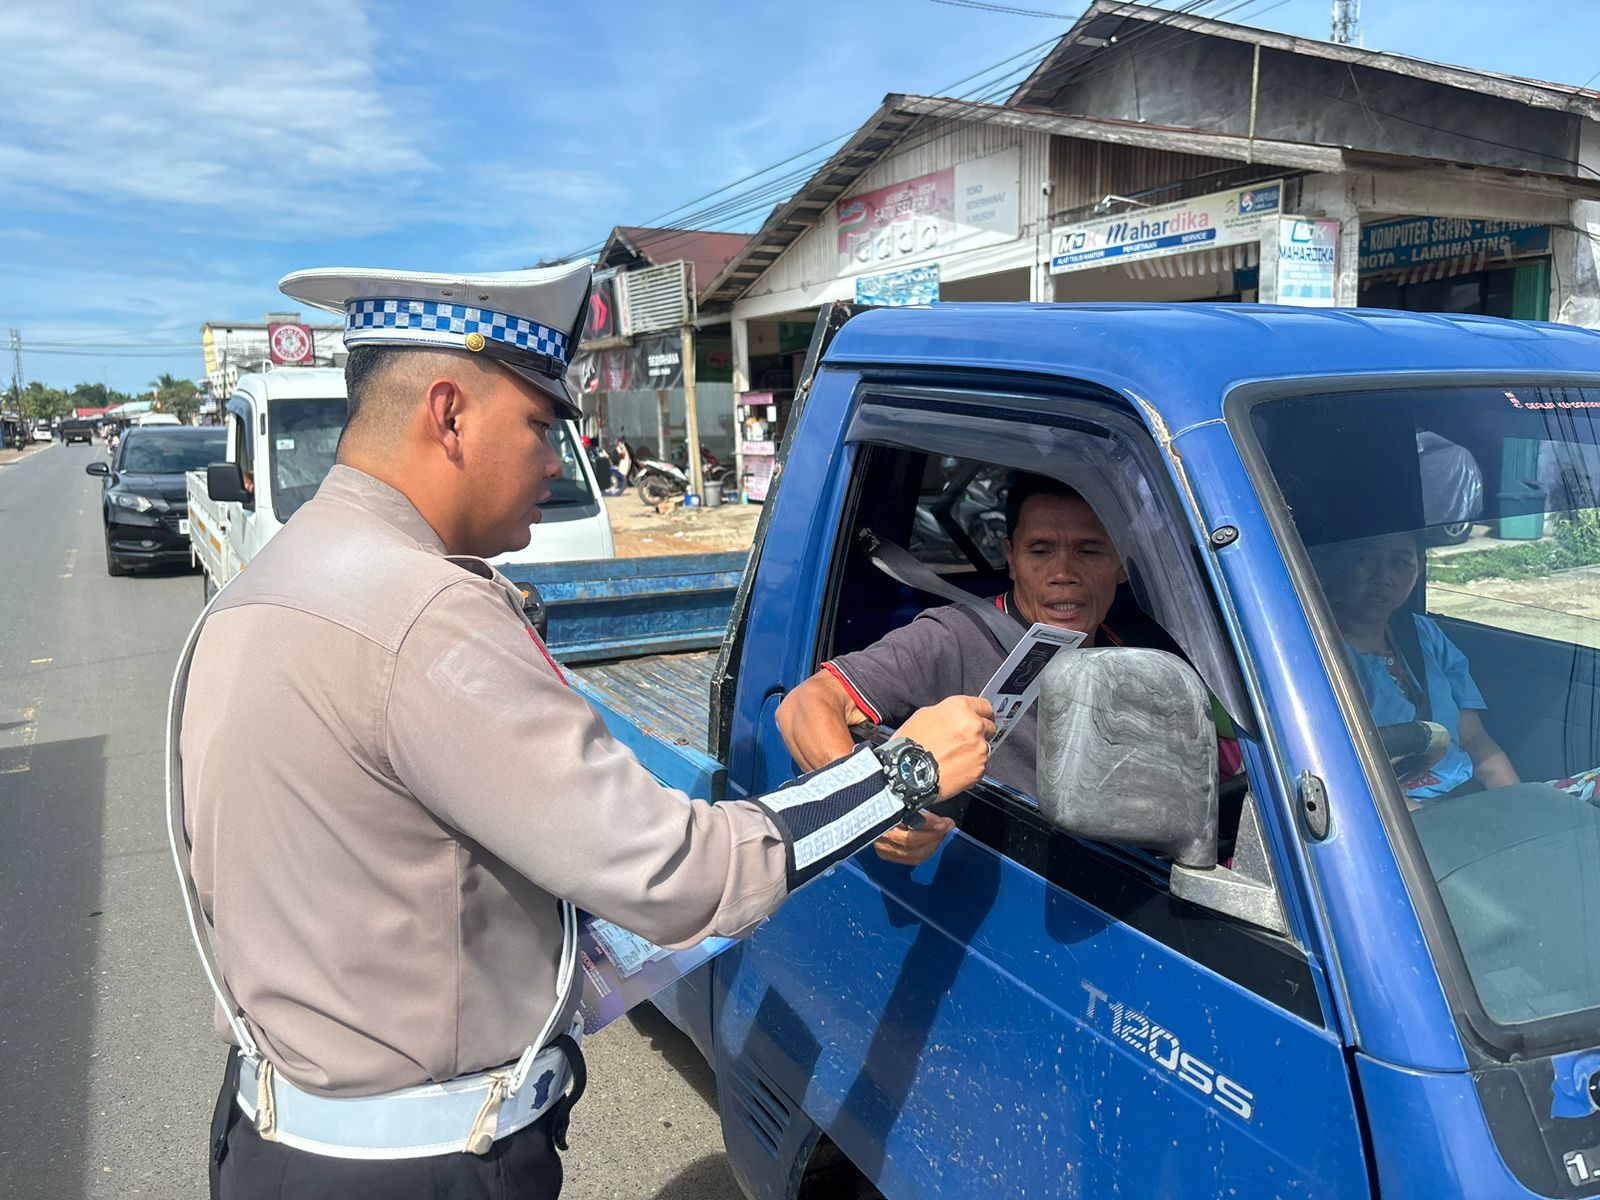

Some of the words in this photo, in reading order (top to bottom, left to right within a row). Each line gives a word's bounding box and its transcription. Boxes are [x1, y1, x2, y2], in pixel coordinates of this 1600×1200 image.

[1106, 211, 1208, 245] Mahardika
[1370, 221, 1429, 251] KOMPUTER
[1431, 218, 1473, 242] SERVIS
[1411, 236, 1511, 262] LAMINATING
[1081, 979, 1254, 1120] T120SS
